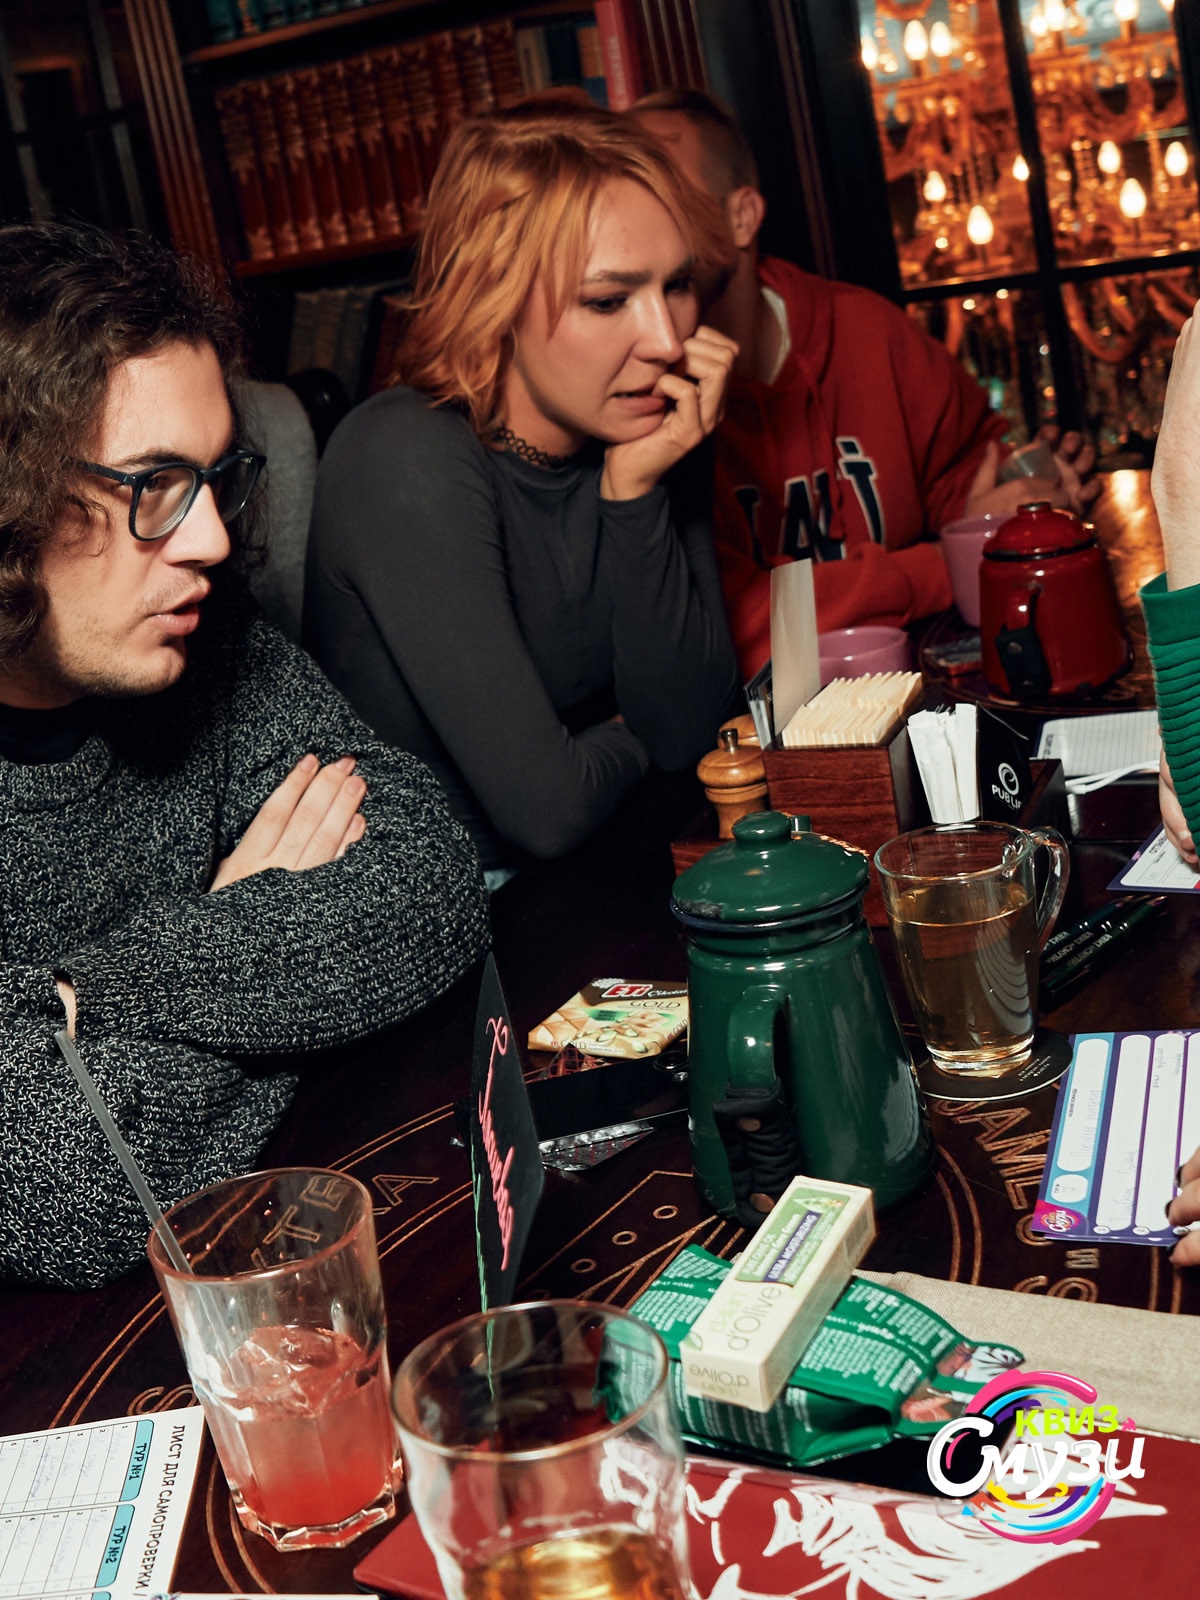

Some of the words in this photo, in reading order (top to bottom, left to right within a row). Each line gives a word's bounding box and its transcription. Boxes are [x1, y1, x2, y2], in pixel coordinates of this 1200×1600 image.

[630, 999, 681, 1009] GOLD
[133, 1442, 147, 1462] ТУР
[168, 1425, 186, 1459] ЛИСТ
[161, 1463, 179, 1486] ДЛЯ
[111, 1525, 127, 1545] ТУР
[135, 1489, 173, 1589] САМОПРОВЕРКИ
